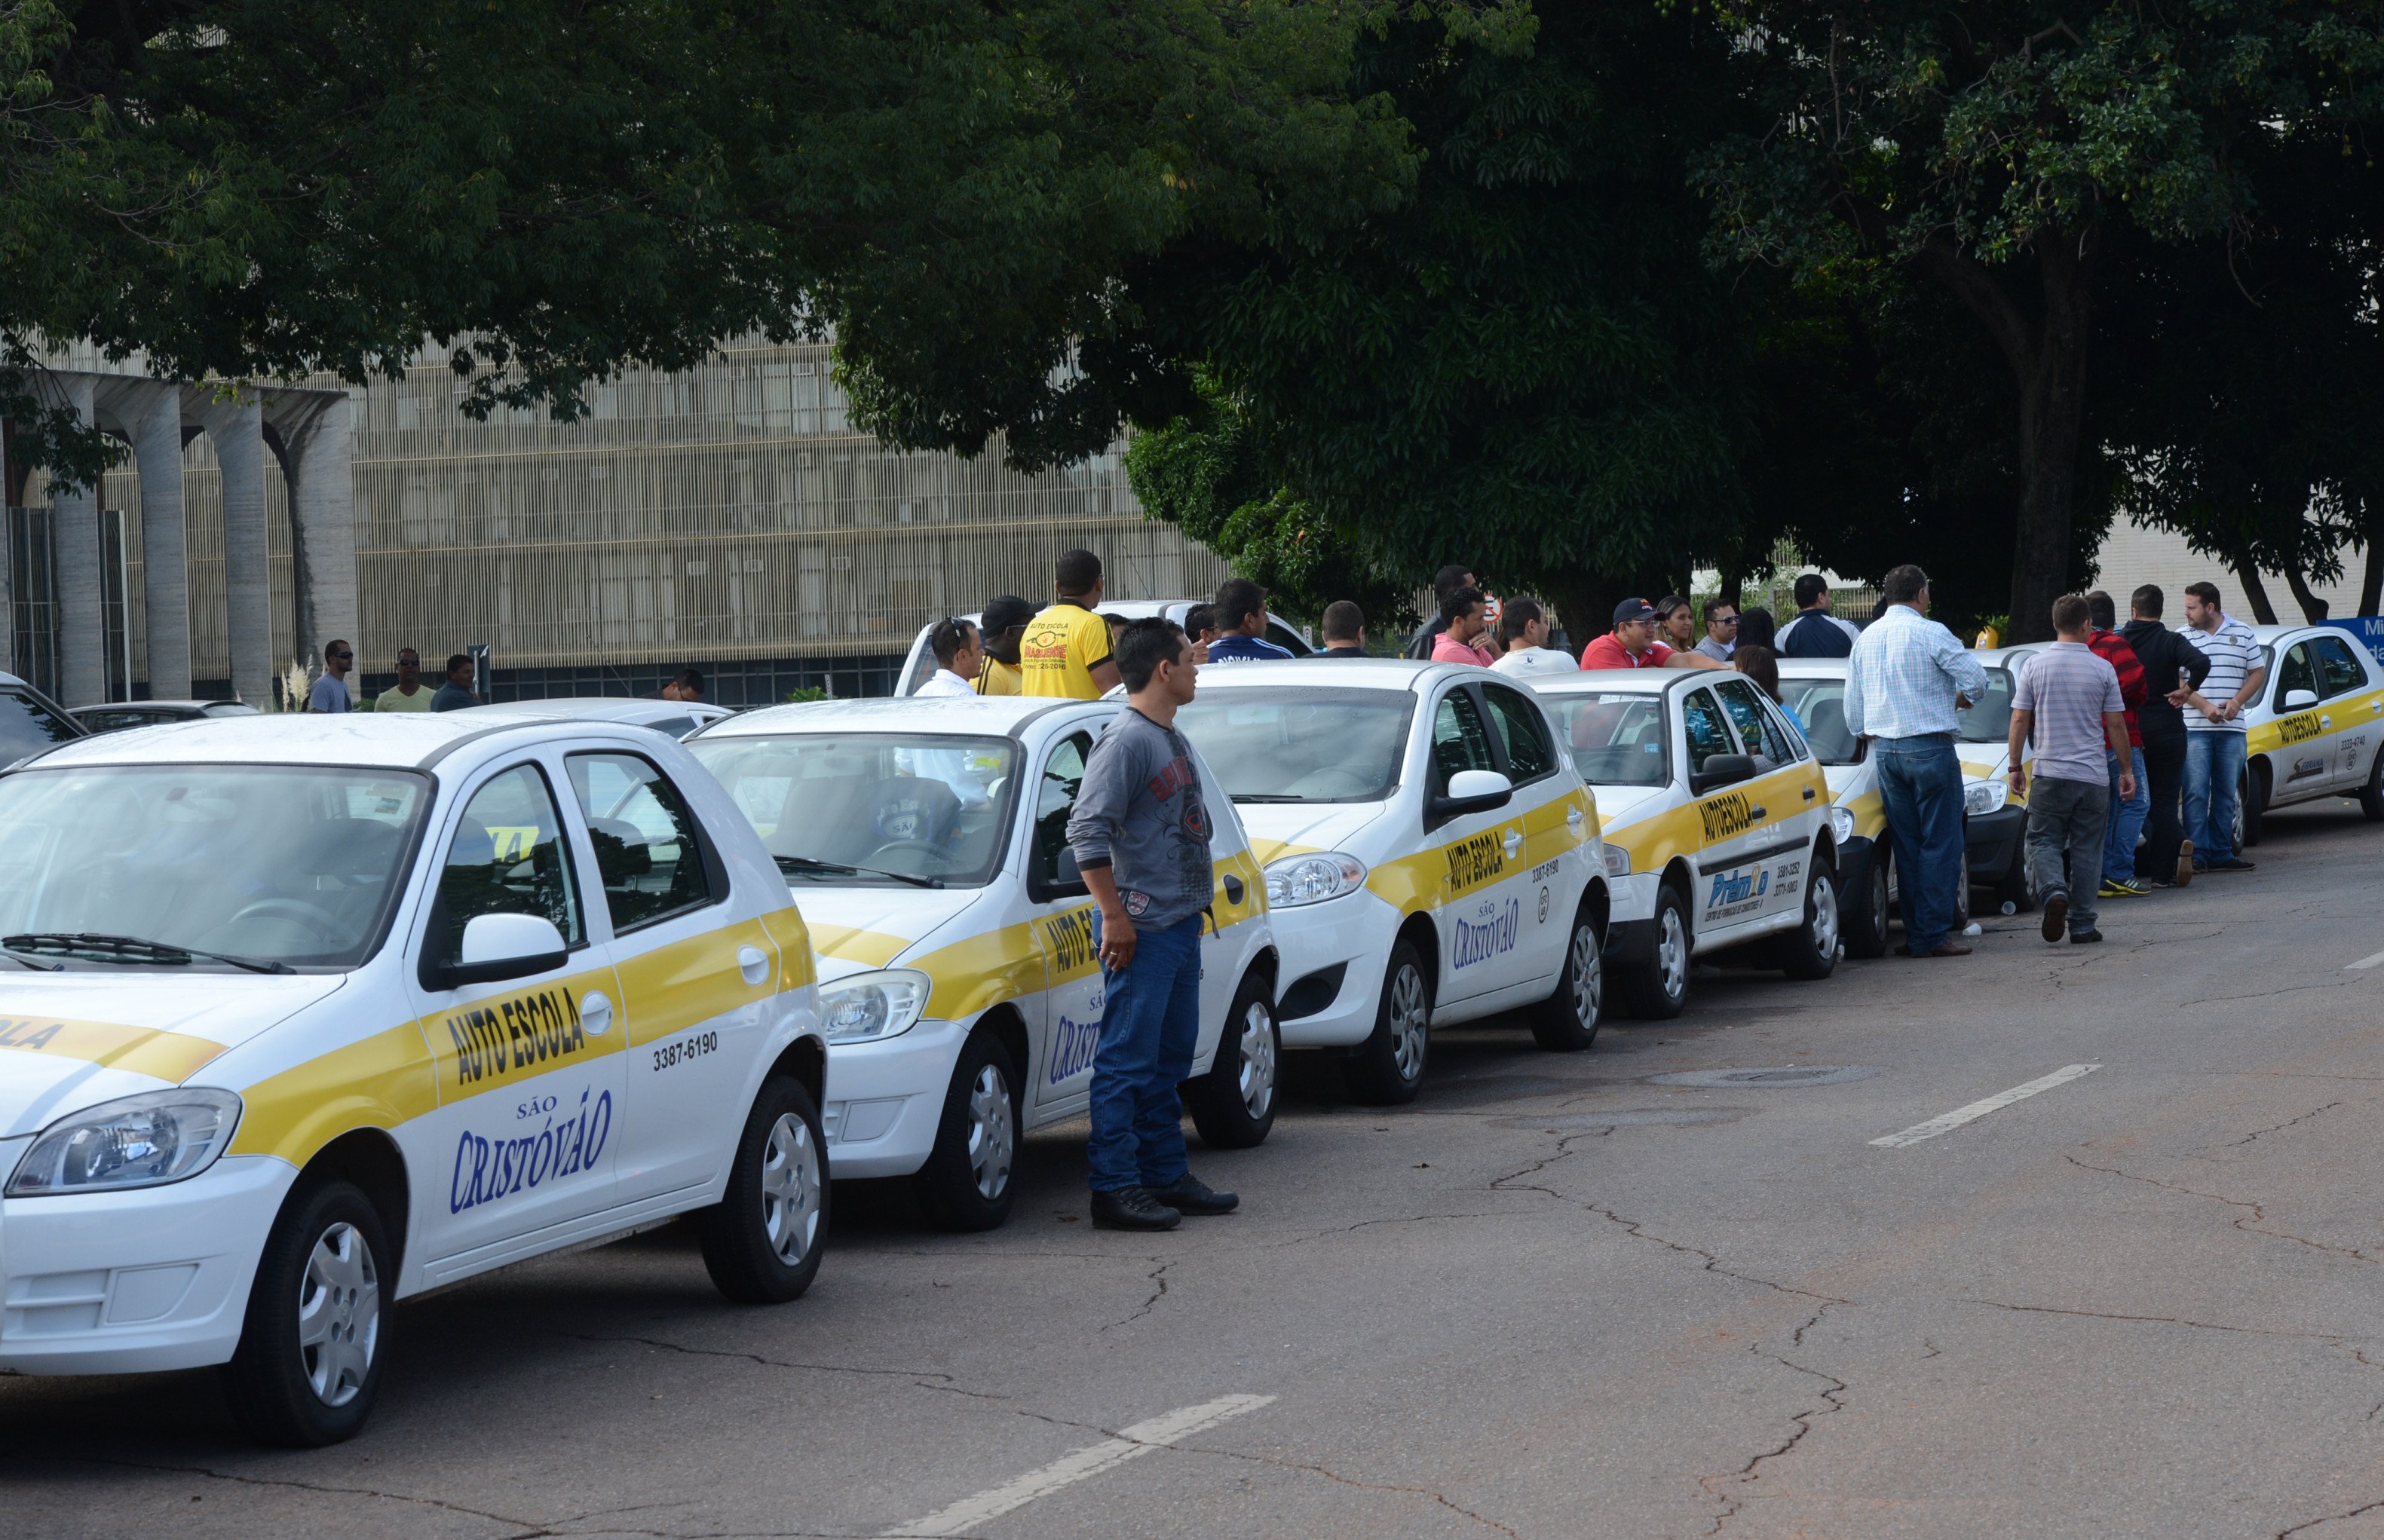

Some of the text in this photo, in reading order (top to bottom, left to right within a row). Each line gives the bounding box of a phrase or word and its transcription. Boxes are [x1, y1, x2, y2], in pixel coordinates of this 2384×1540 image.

[2277, 712, 2321, 745] AUTOESCOLA
[2341, 735, 2366, 751] 3333-4740
[1699, 791, 1753, 842] AUTOESCOLA
[1447, 831, 1503, 892] AUTO ESCOLA
[1532, 859, 1559, 883] 3387-6190
[1479, 900, 1495, 917] SÃO
[1046, 914, 1084, 973] AUTO
[1454, 894, 1518, 970] CRISTÓVÃO
[447, 987, 584, 1085] AUTO ESCOLA
[654, 1030, 717, 1071] 3387-6190
[516, 1095, 557, 1119] SÃO
[450, 1084, 611, 1214] CRISTÓVÃO
